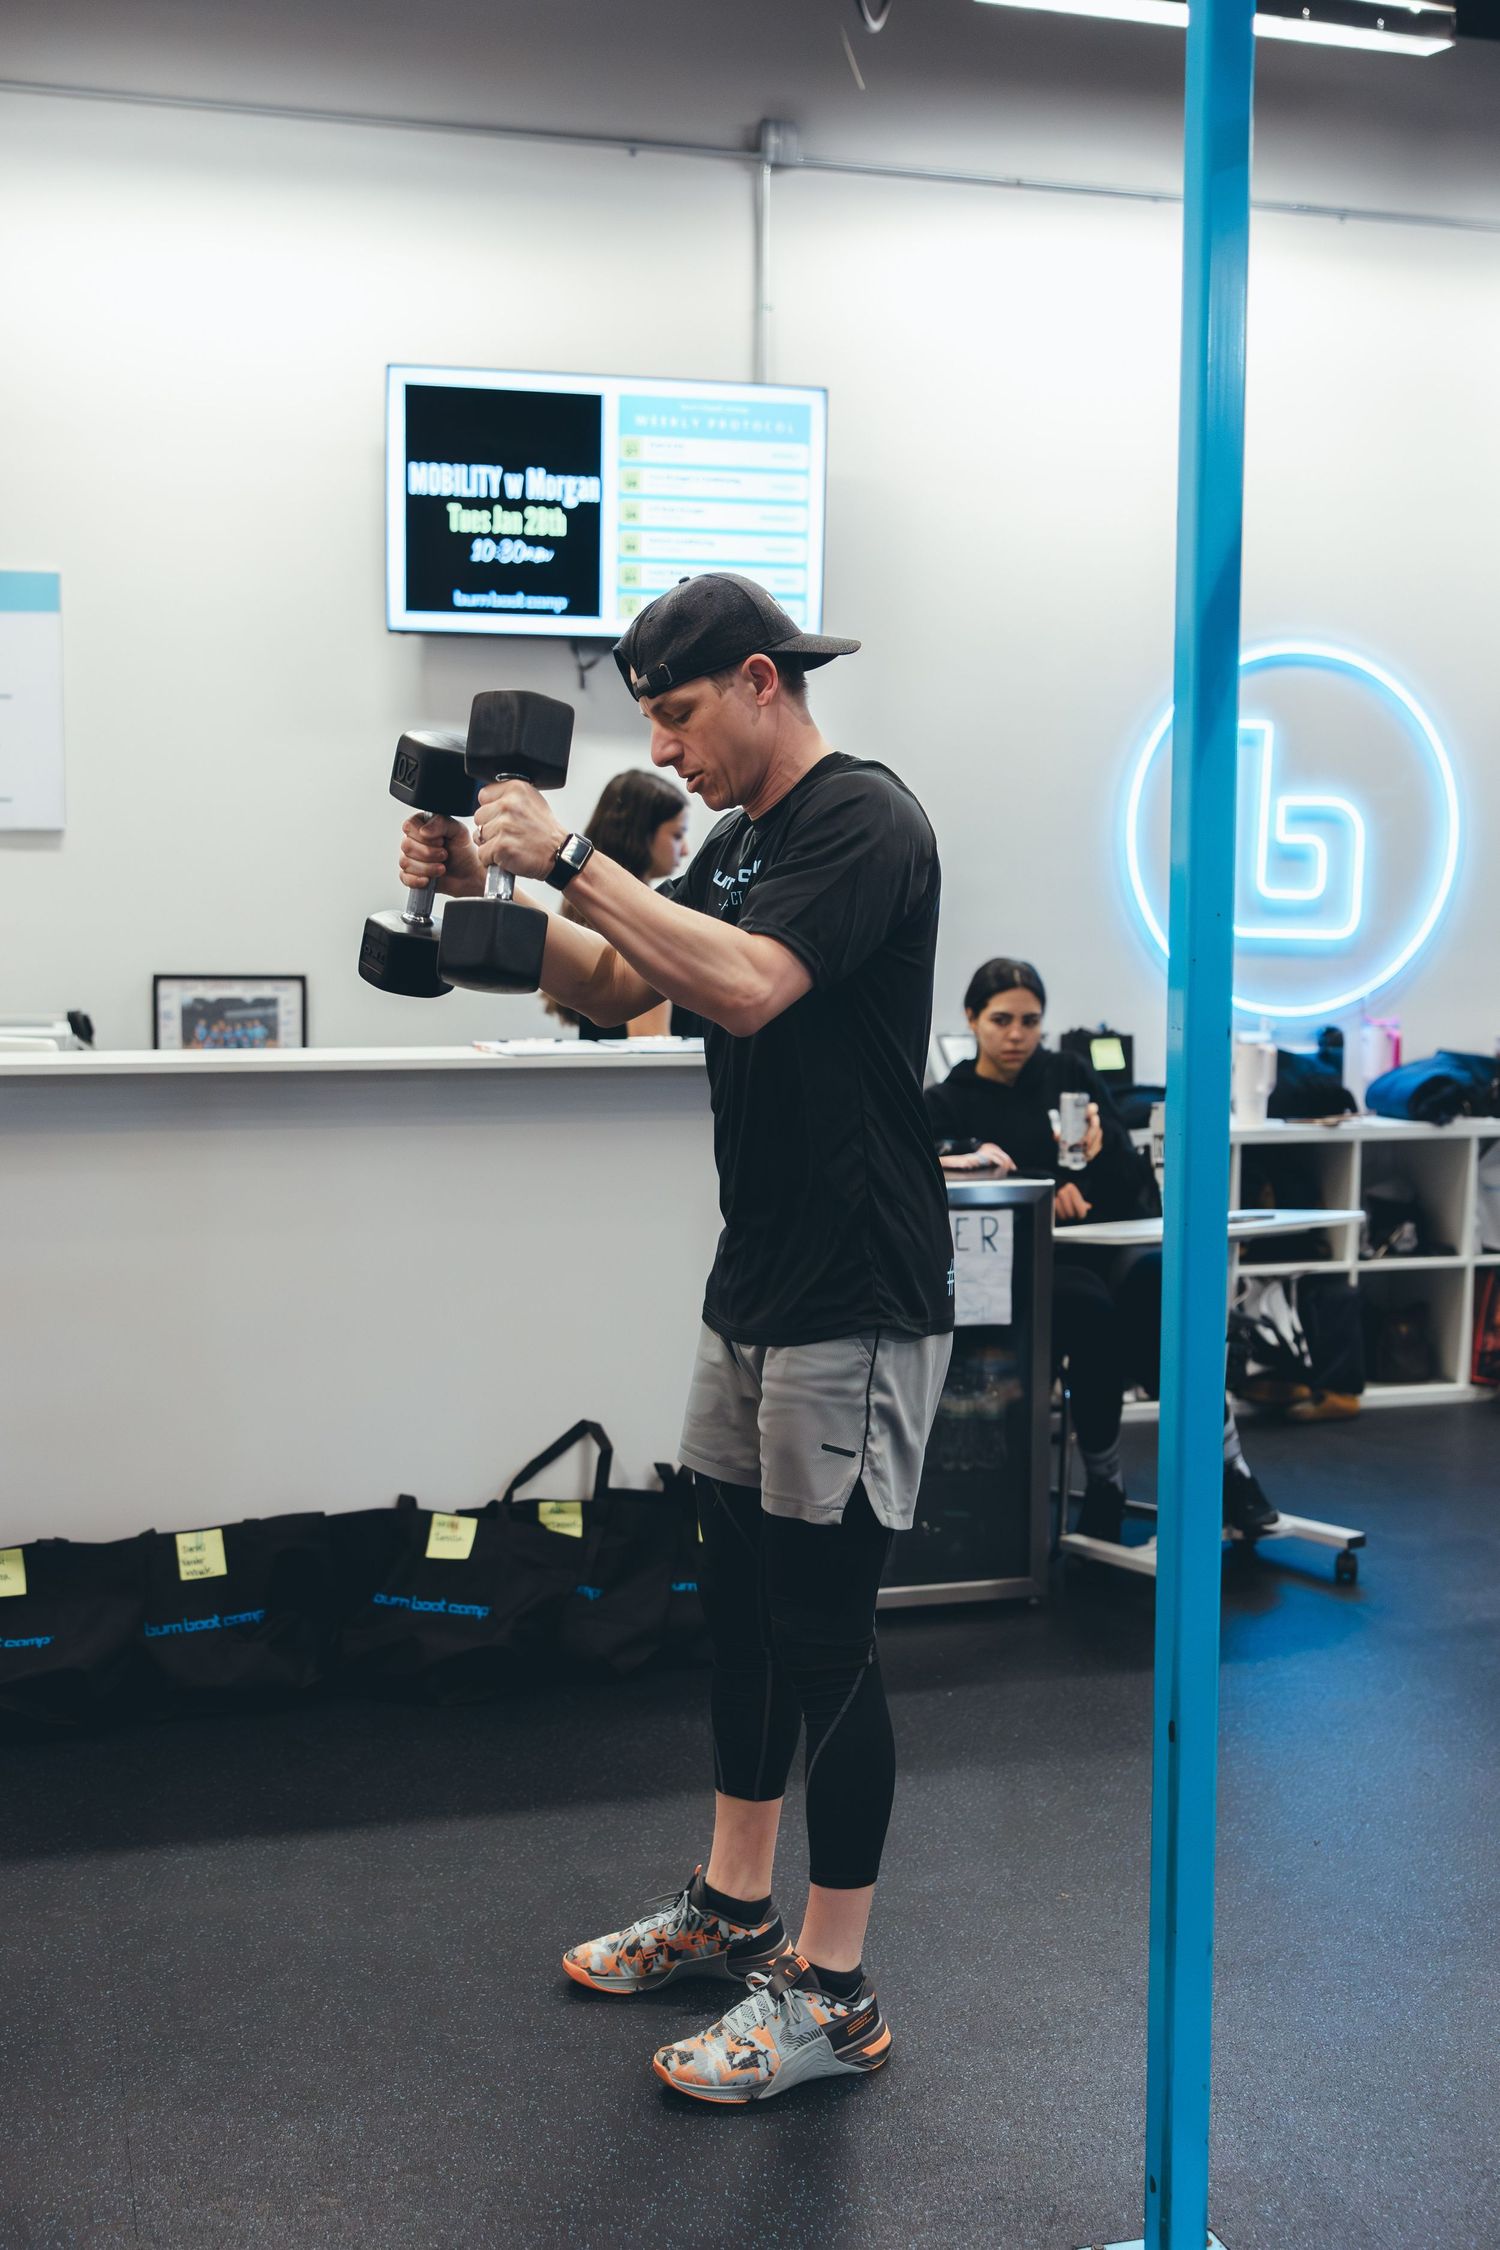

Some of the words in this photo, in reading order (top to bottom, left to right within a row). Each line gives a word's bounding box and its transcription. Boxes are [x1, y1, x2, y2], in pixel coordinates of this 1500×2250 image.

[408, 461, 503, 498] MOBILITY
[504, 473, 524, 499] w
[525, 467, 600, 509] Morgan
[446, 502, 492, 534] Tues
[491, 504, 523, 535] Jan
[410, 1595, 446, 1612] boot
[448, 1602, 490, 1620] camp
[144, 1619, 183, 1638] burn
[183, 1614, 222, 1632] boot
[4, 1635, 52, 1648] camp
